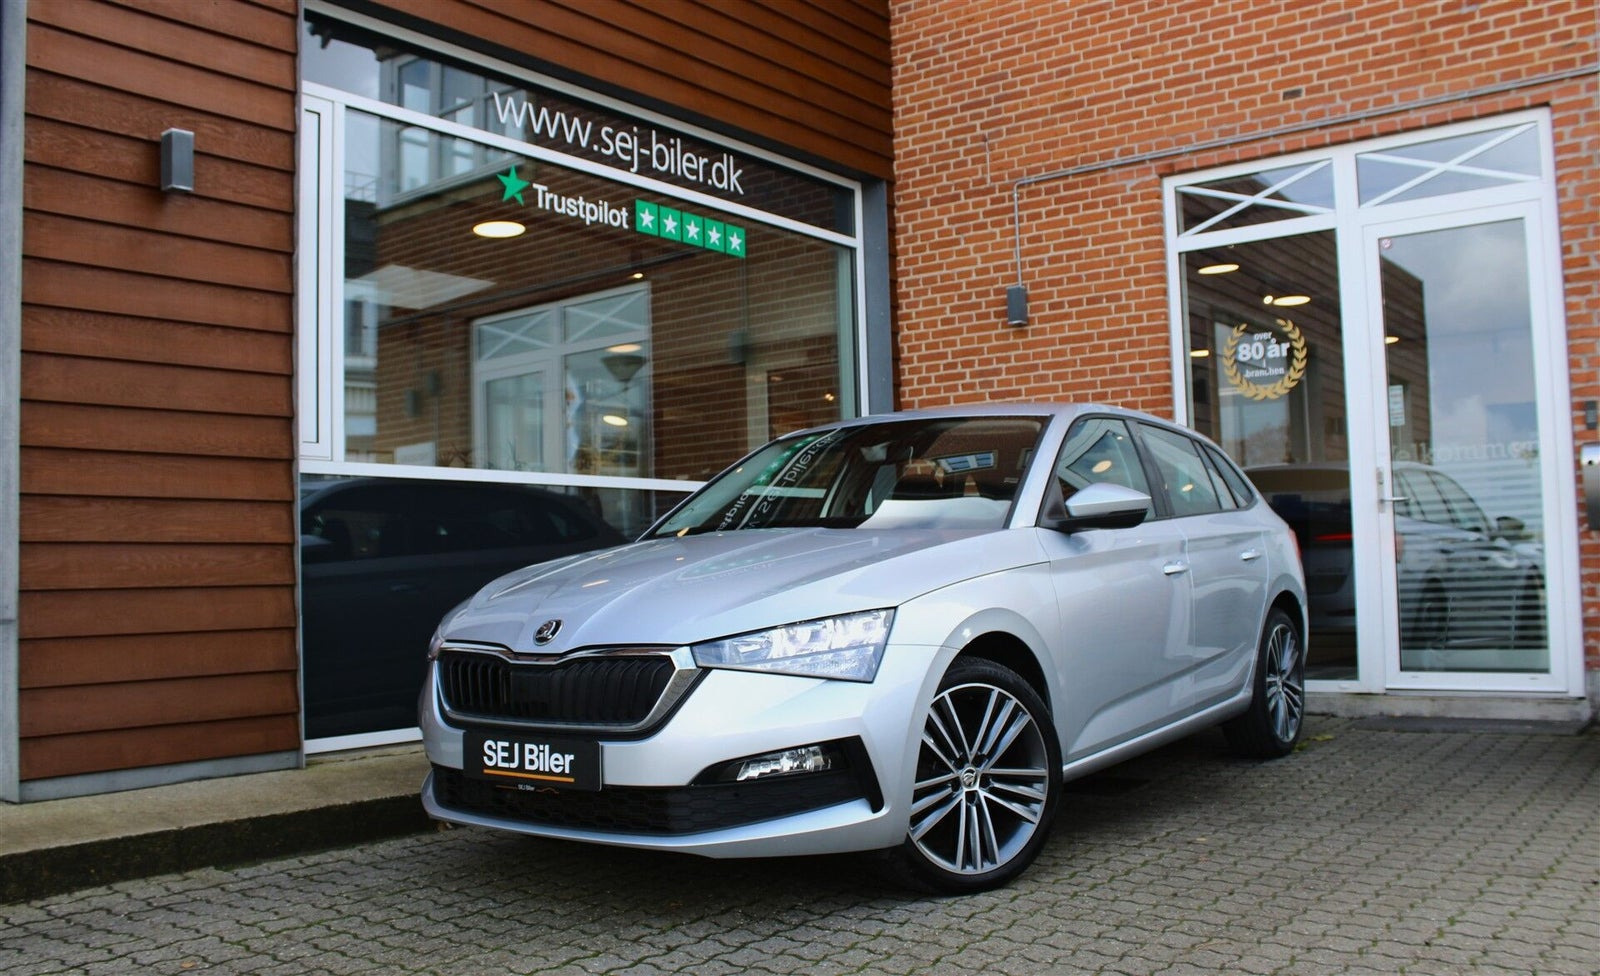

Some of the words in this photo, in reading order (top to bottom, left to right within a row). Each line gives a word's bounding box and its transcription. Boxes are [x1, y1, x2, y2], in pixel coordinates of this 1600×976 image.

[493, 91, 745, 195] www.sej-biler.dk
[532, 182, 629, 229] Trustpilot
[1238, 342, 1265, 361] 80
[1267, 338, 1290, 358] år
[1254, 332, 1272, 341] over
[483, 740, 519, 768] SEJ
[524, 743, 574, 773] Biler
